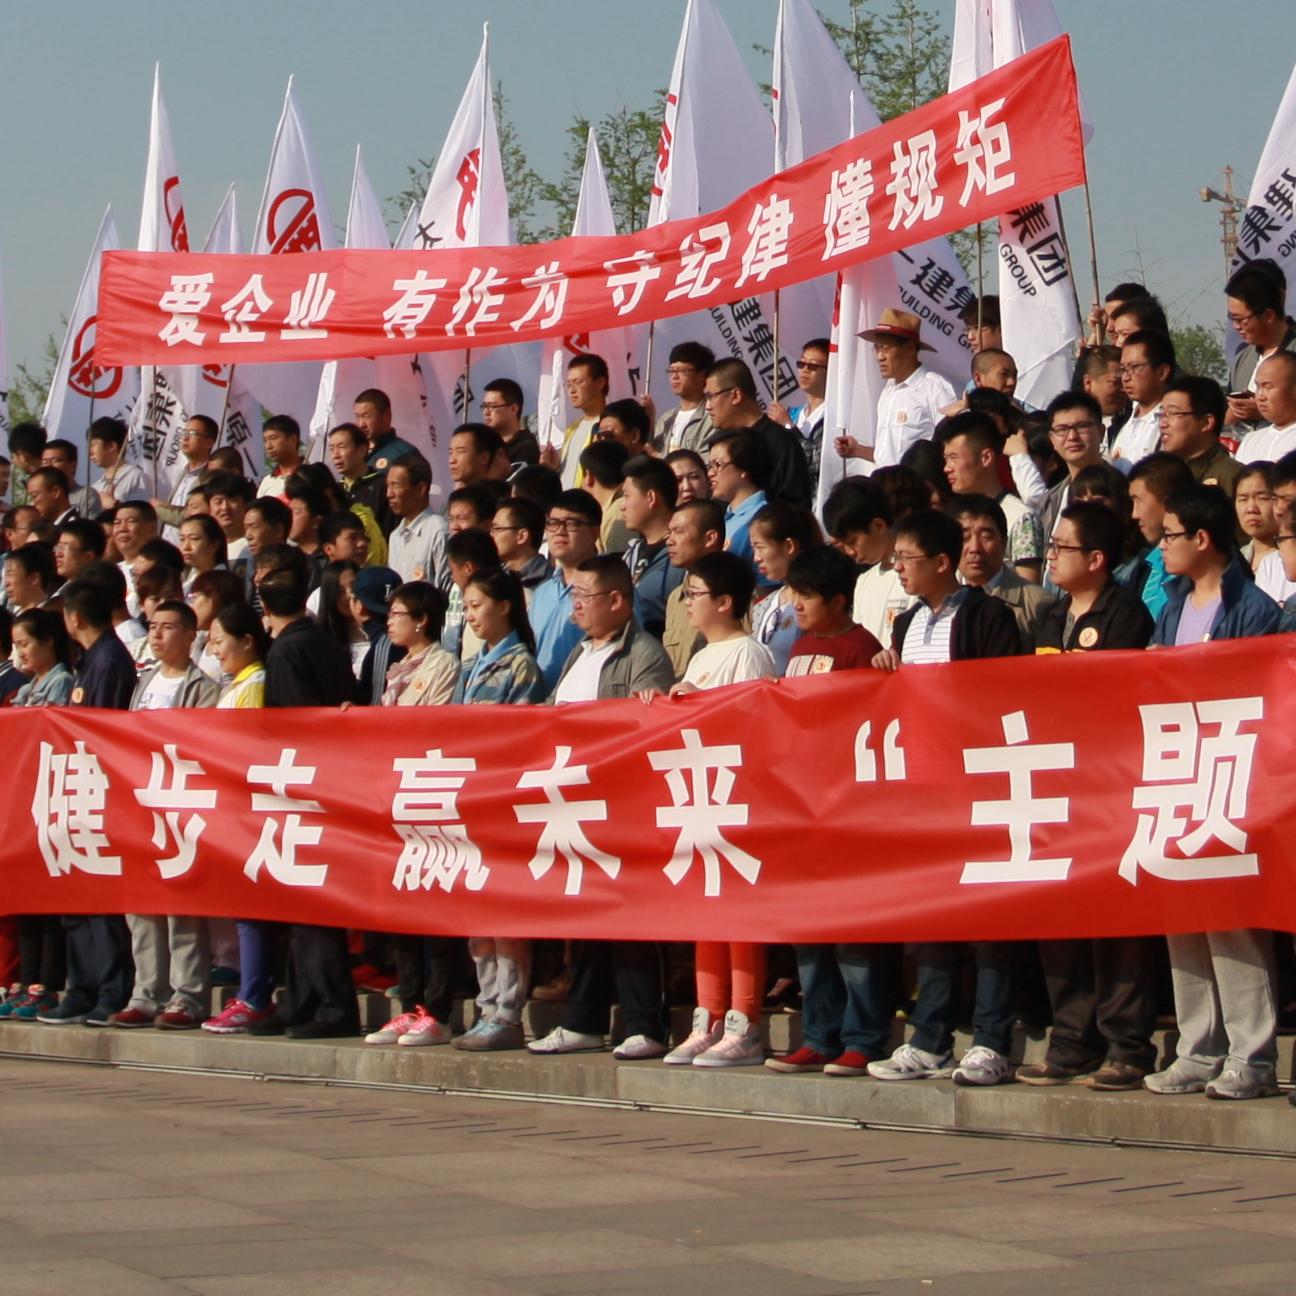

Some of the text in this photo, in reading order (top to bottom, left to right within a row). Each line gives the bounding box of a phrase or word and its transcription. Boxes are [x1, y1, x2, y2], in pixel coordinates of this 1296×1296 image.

[158, 97, 1016, 347] 爱企业 有作为 守纪律 懂规矩
[999, 243, 1037, 298] GROUP
[898, 284, 955, 337] UILDING
[31, 740, 329, 887] 健步走
[391, 728, 762, 897] 赢未来
